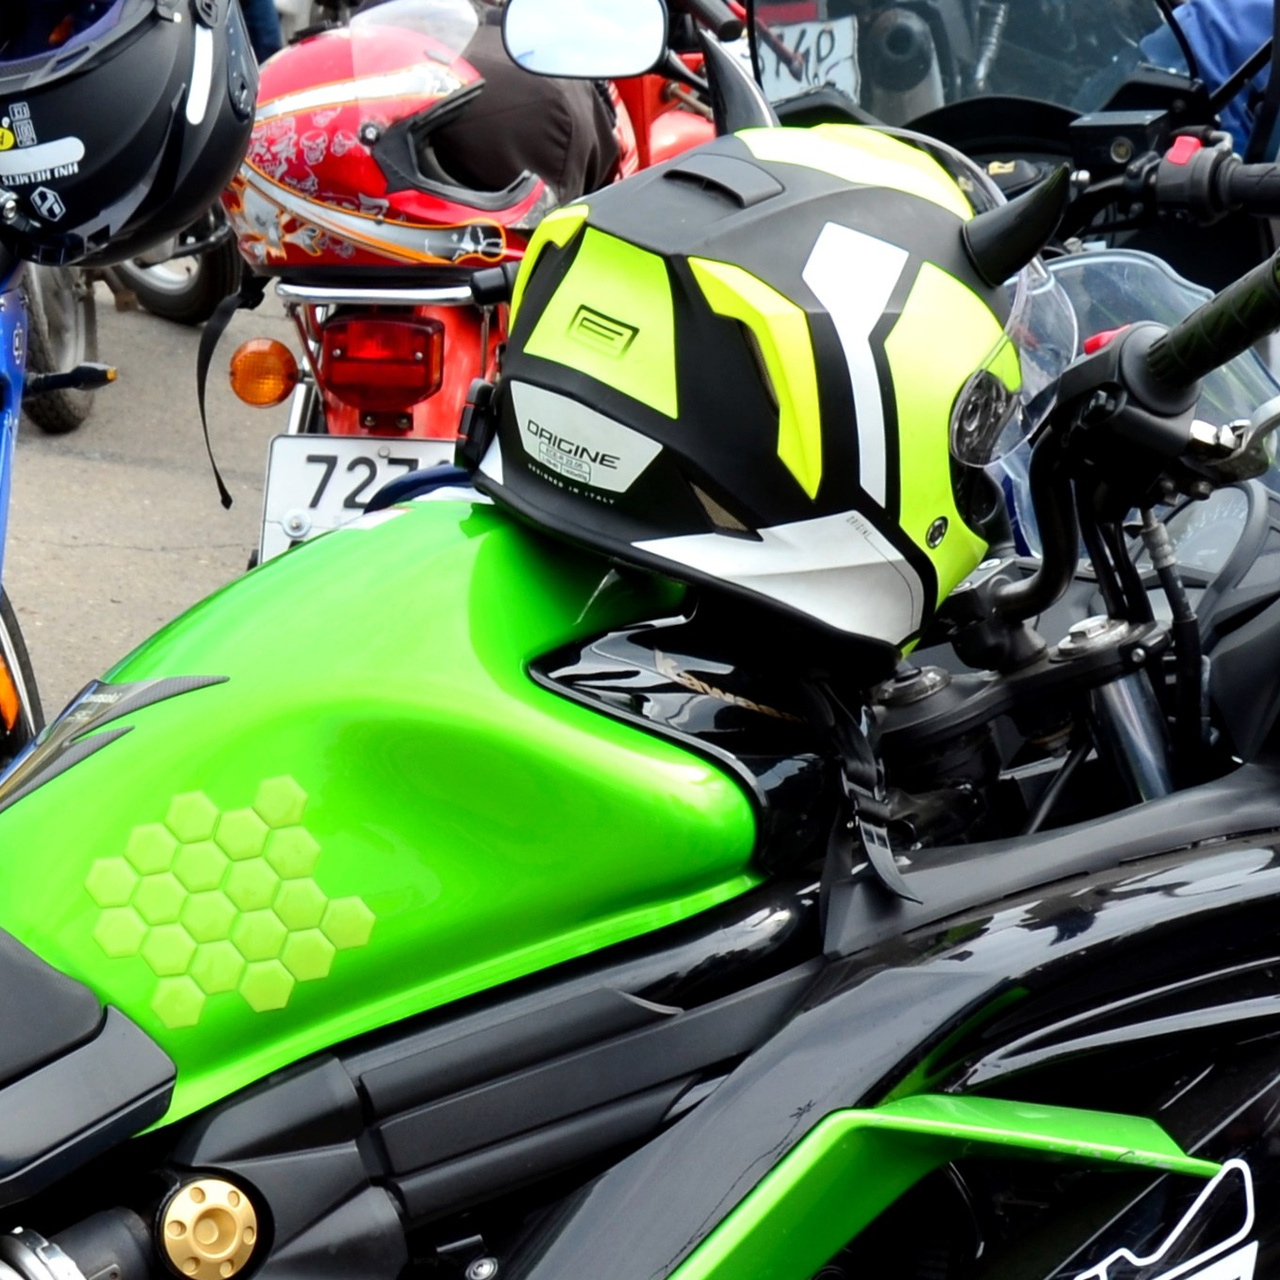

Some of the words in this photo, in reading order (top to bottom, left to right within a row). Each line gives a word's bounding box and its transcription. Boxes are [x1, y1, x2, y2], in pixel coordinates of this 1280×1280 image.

[2, 169, 52, 186] HELMETS
[54, 161, 79, 179] HNJ
[527, 419, 621, 470] ORIGINE
[306, 455, 450, 510] 72
[584, 491, 615, 505] ITALY
